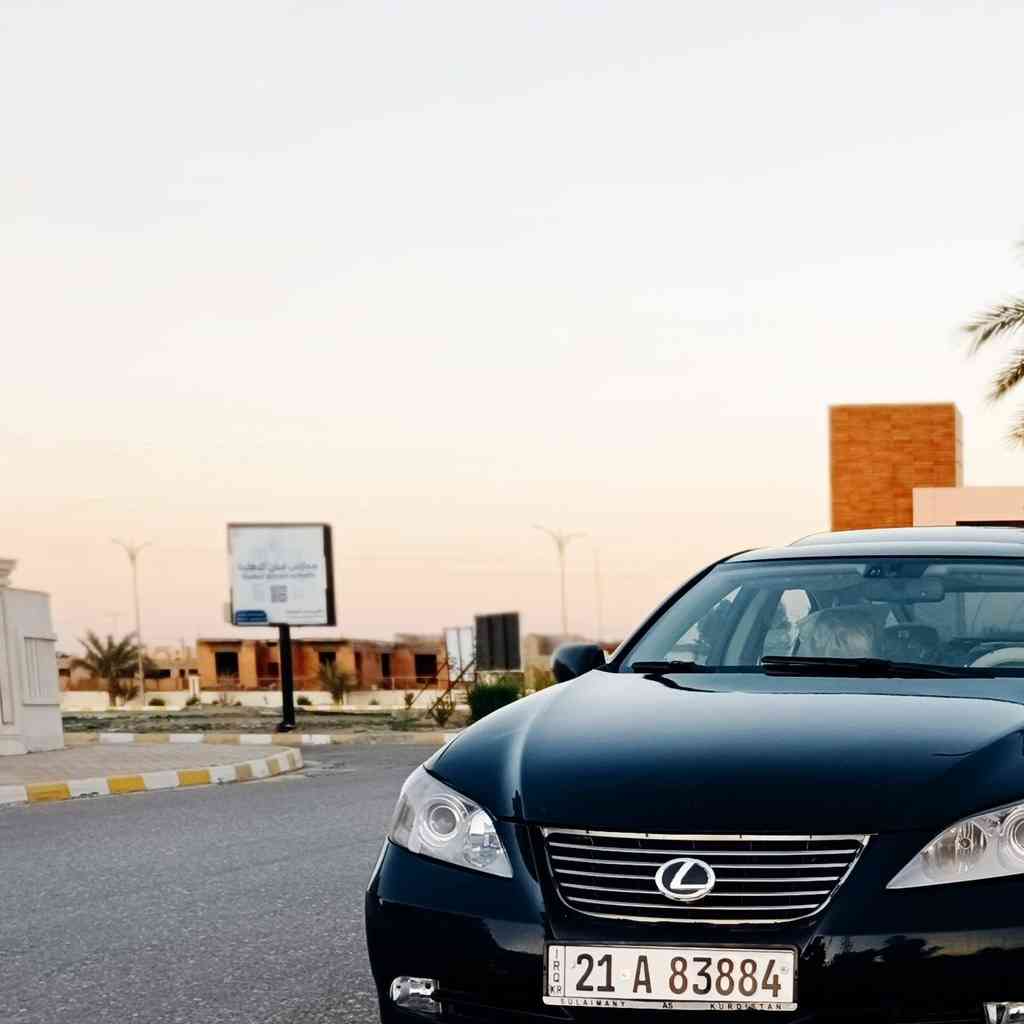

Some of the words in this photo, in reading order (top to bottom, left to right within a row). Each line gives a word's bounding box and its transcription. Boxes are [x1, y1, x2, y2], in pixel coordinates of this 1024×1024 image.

[575, 953, 616, 992] 21
[632, 955, 652, 993] A
[669, 956, 782, 998] 83884
